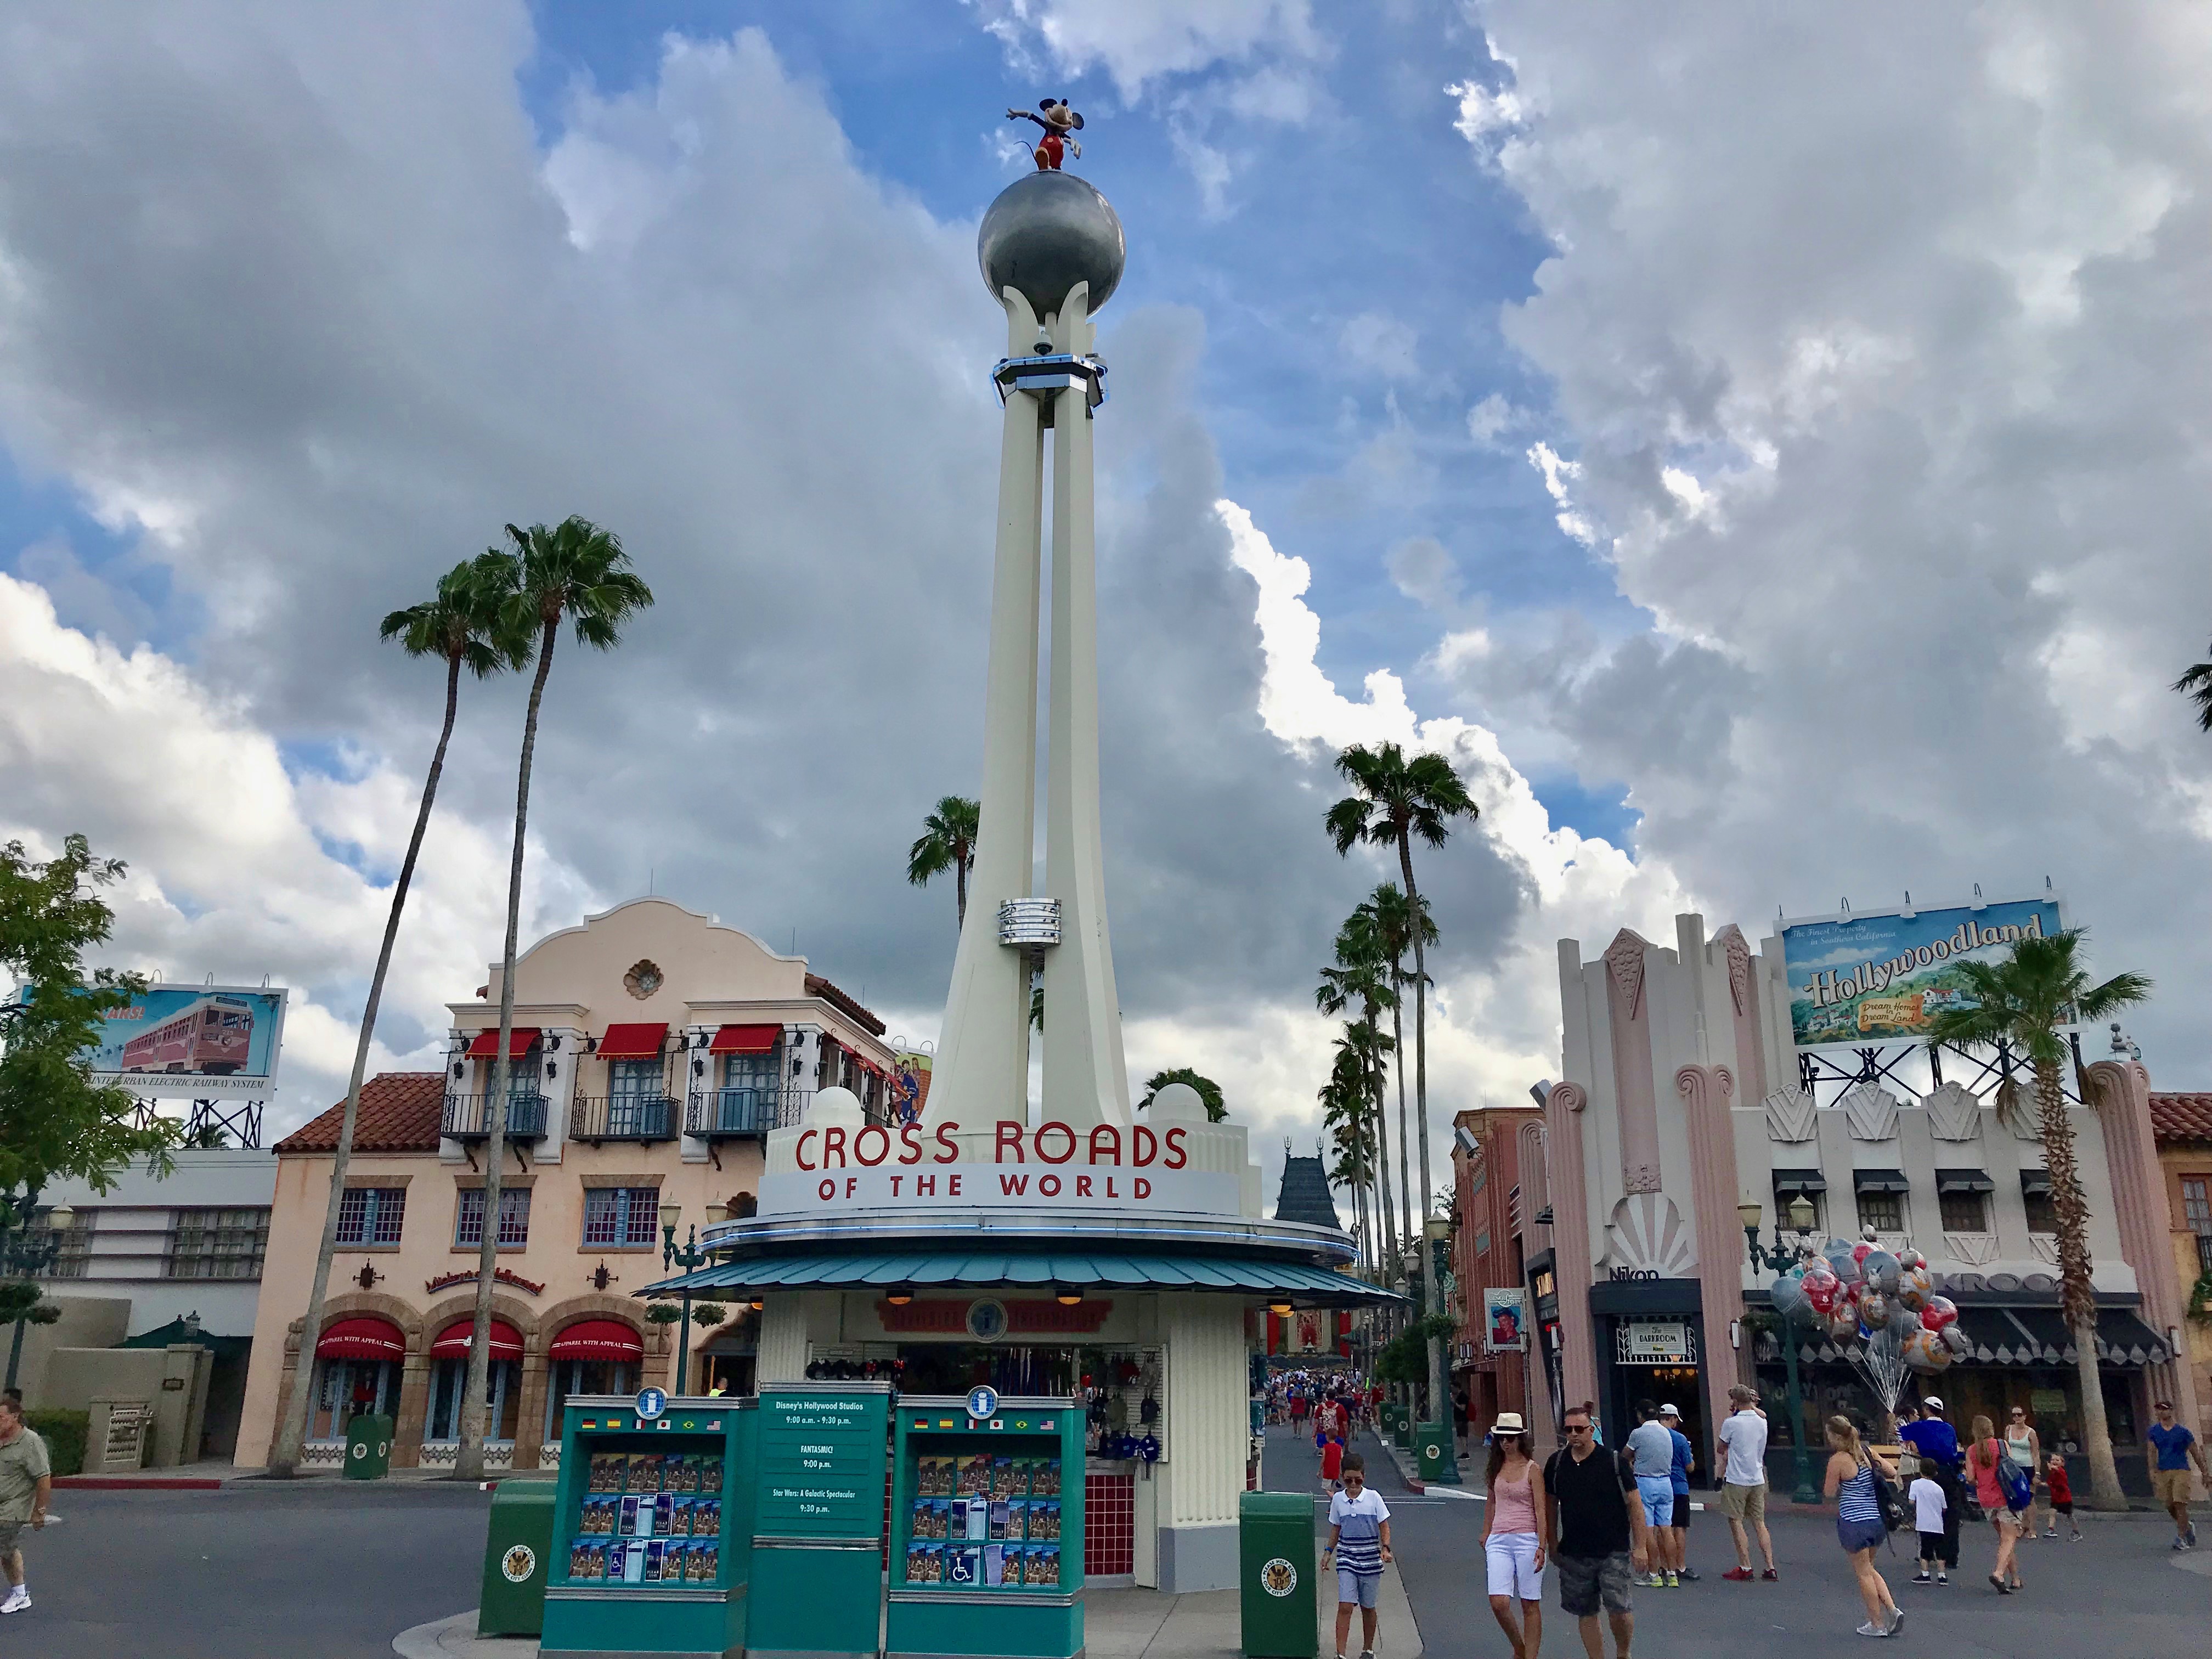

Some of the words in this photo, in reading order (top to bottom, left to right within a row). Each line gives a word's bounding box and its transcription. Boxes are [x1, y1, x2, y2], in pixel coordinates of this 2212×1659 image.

[1791, 930, 1805, 938] The
[1808, 928, 1830, 937] Finest
[1832, 925, 1866, 935] Property
[1820, 935, 1853, 944] Southern
[1855, 932, 1895, 941] California
[1803, 913, 2047, 1009] Hollywoodland
[1894, 1002, 1919, 1011] Homes
[100, 1006, 145, 1020] ARS!
[1861, 1014, 1889, 1022] Dream
[1890, 1012, 1915, 1023] Land
[91, 1076, 146, 1085] INTERBAN
[149, 1077, 191, 1086] ELECTRIC
[192, 1079, 232, 1087] RAILWAY
[231, 1080, 264, 1088] SYSTEM
[796, 1121, 960, 1171] CROSS
[995, 1120, 1187, 1169] ROADS
[819, 1177, 857, 1200] OF
[890, 1174, 962, 1197] THE
[999, 1174, 1152, 1199] WORLD
[1609, 1266, 1661, 1283] Nikon
[361, 1338, 382, 1346] APPEAL
[776, 1401, 803, 1411] Disney's
[804, 1402, 838, 1411] Hollywood
[839, 1402, 864, 1410] Studios
[800, 1445, 833, 1454] FANTASMIC!
[784, 1489, 799, 1497] Wars:
[805, 1489, 825, 1497] Galactic
[826, 1489, 856, 1499] Spectacular
[1263, 1581, 1271, 1590] OUR
[1284, 1582, 1295, 1594] CLEAN
